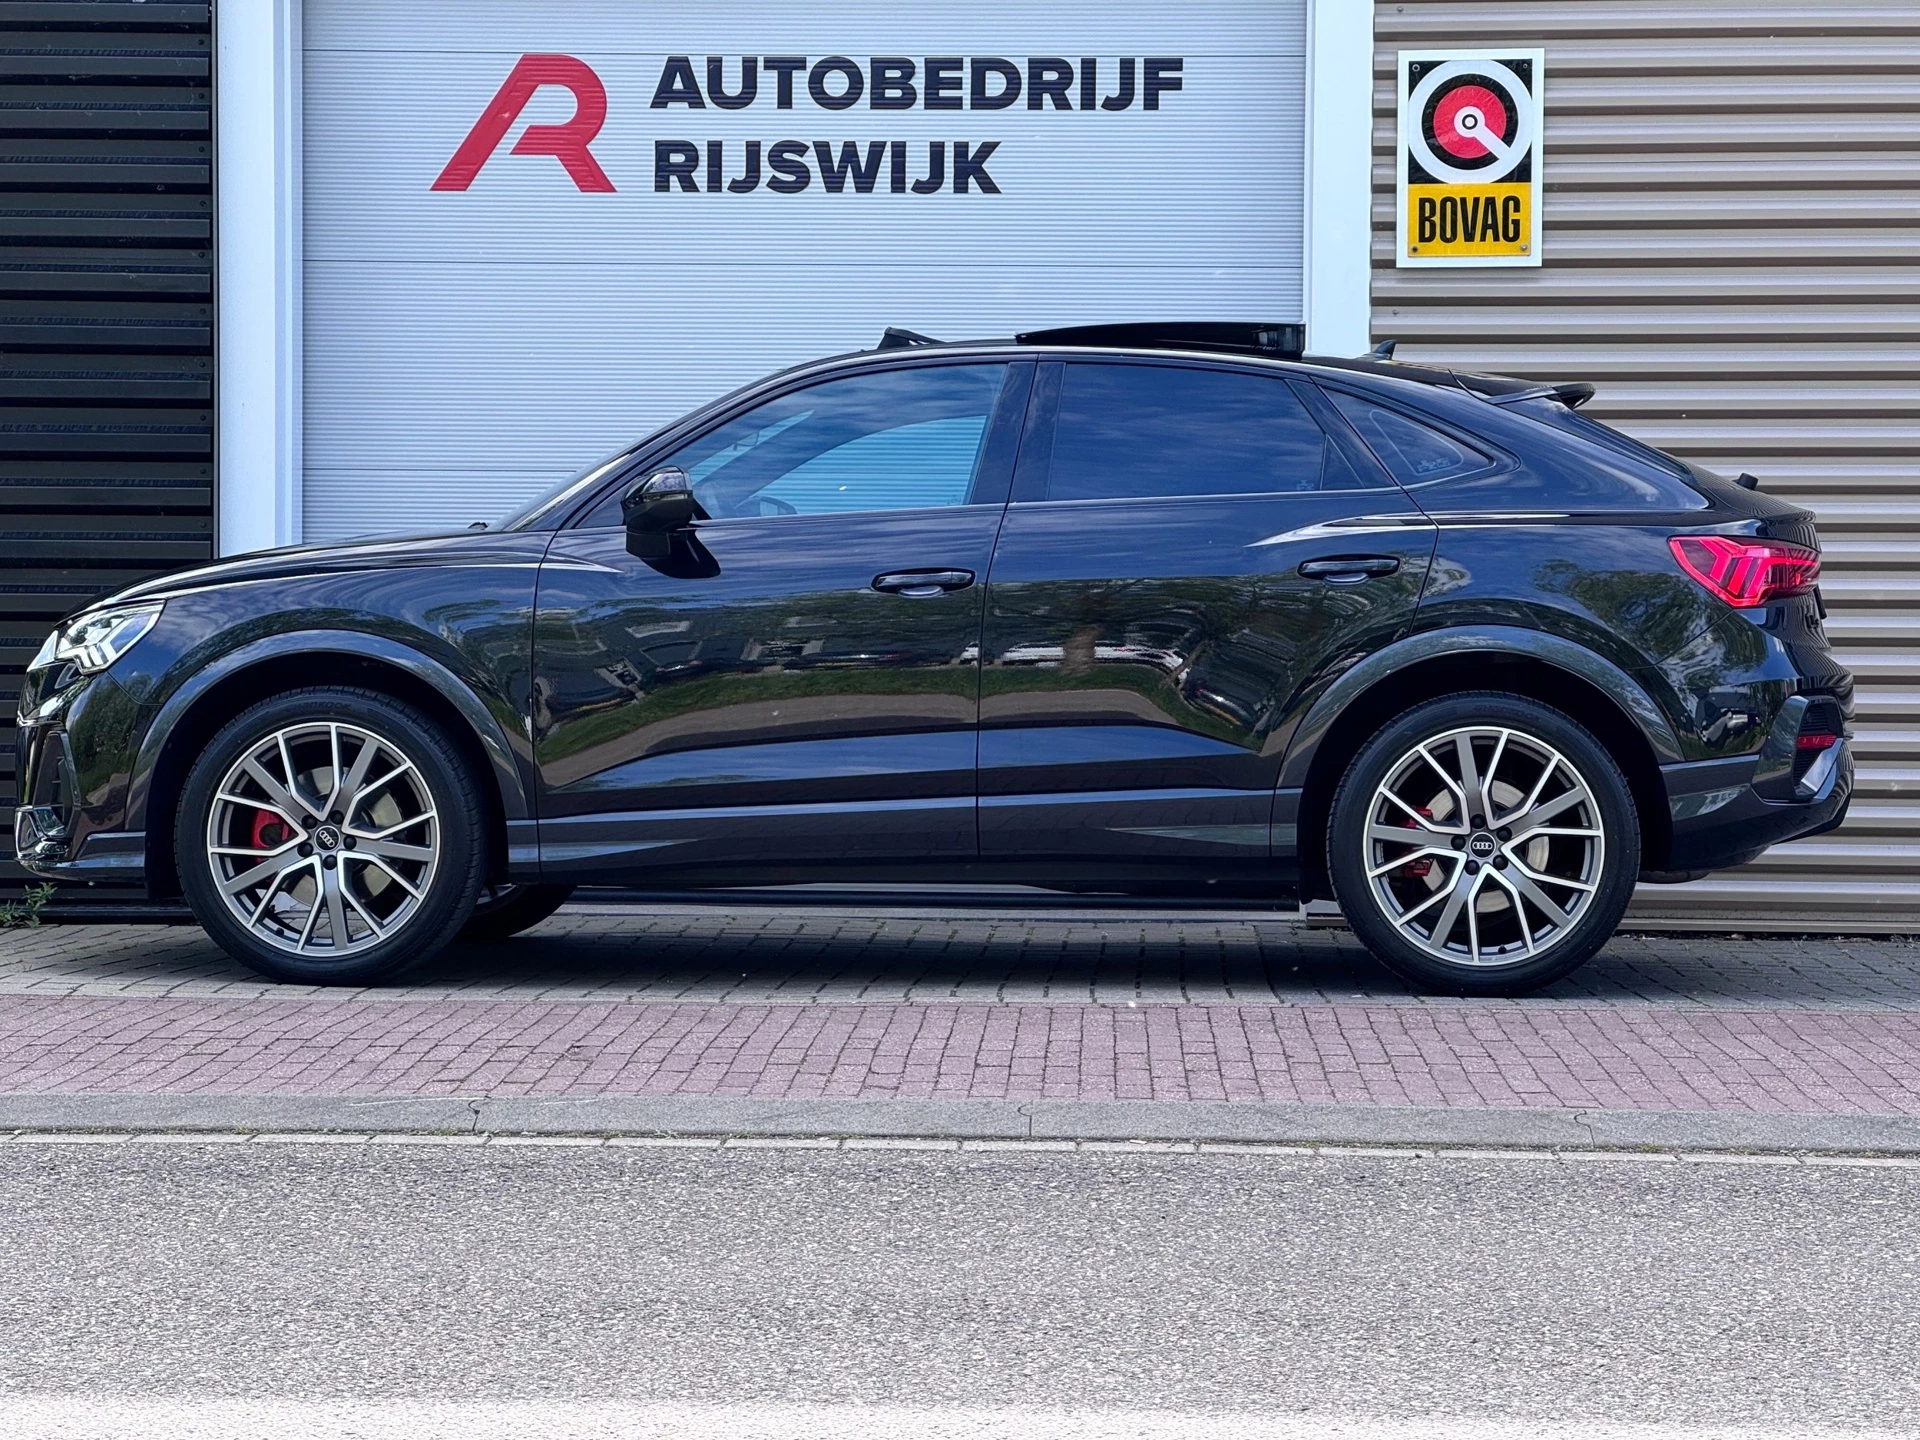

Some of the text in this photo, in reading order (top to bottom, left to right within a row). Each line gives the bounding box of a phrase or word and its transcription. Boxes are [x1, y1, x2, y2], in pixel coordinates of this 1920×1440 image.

[650, 56, 1184, 112] AUTOBEDRIJF
[654, 139, 1002, 194] RIJSWIJK
[1418, 195, 1521, 243] BOVAG
